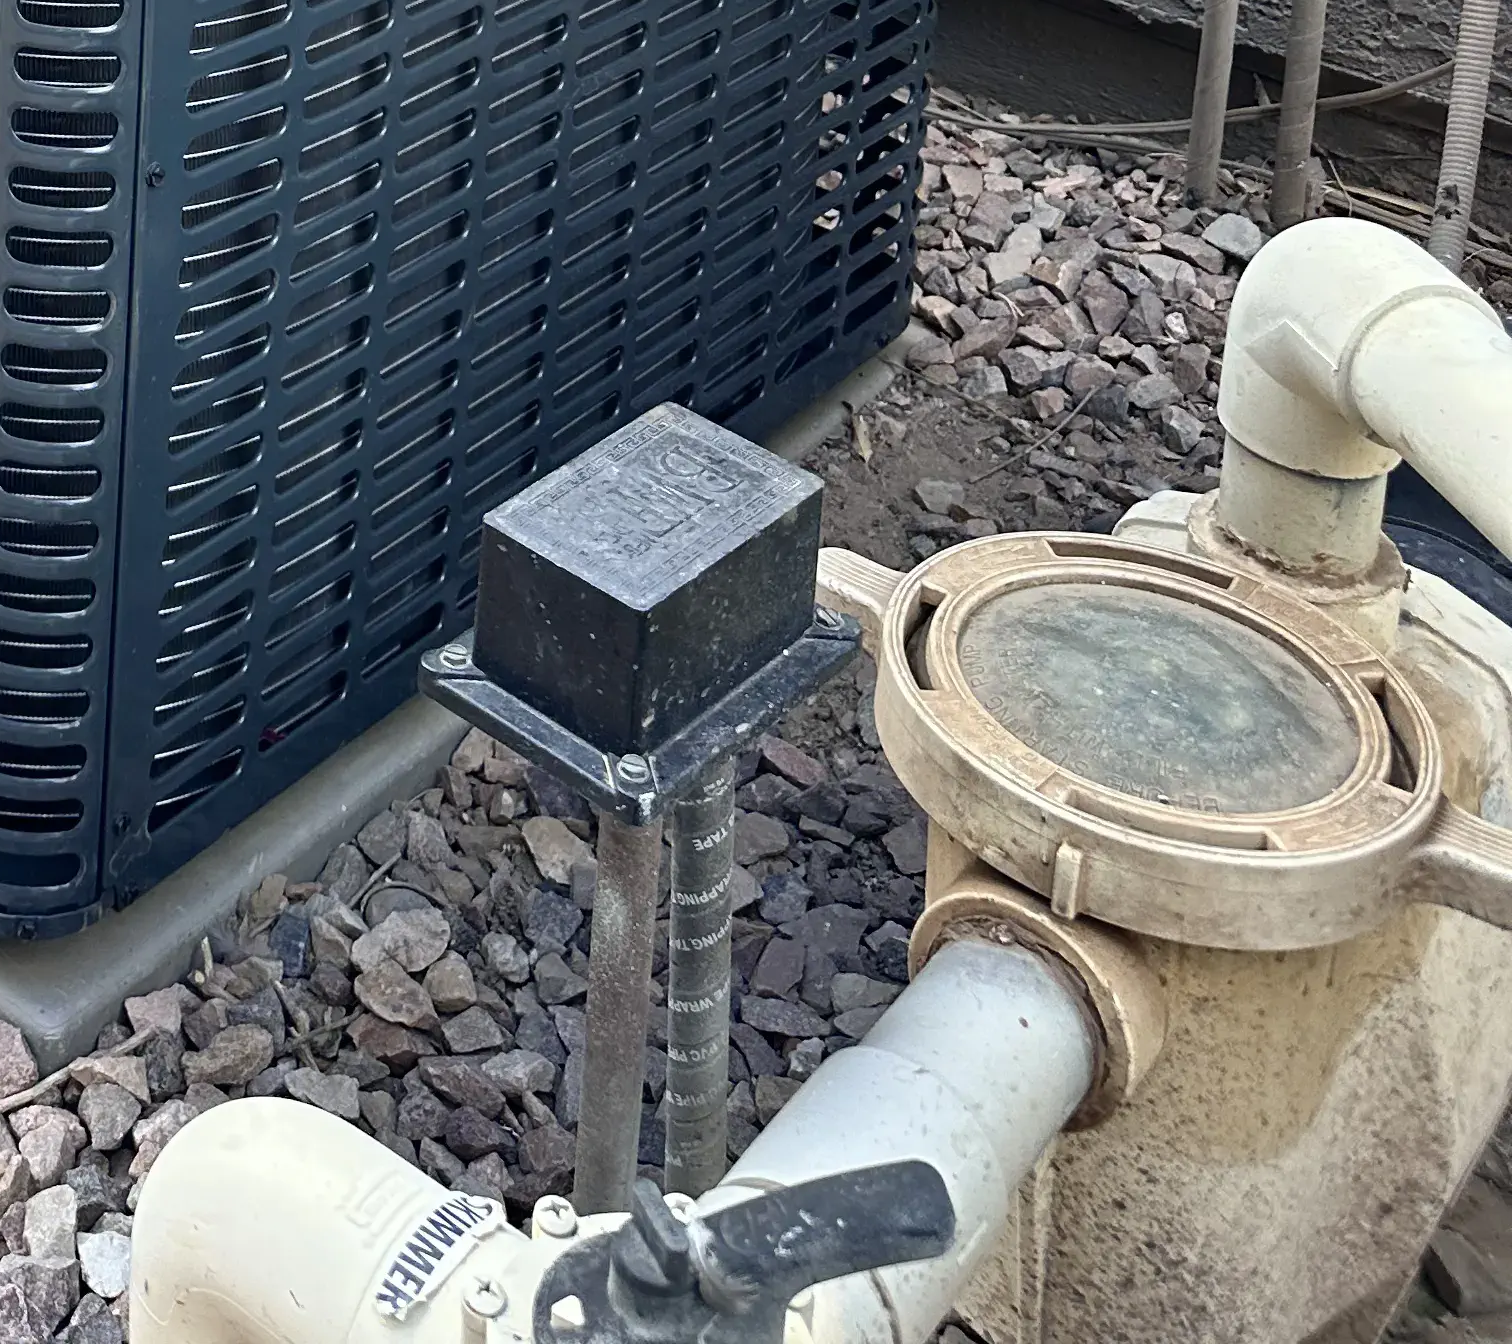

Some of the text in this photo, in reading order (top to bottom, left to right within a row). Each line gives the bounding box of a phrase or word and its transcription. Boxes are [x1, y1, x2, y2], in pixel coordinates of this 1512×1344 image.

[963, 644, 988, 688] PUMP
[692, 827, 727, 851] TAPE
[376, 1197, 493, 1309] SKIMMER
